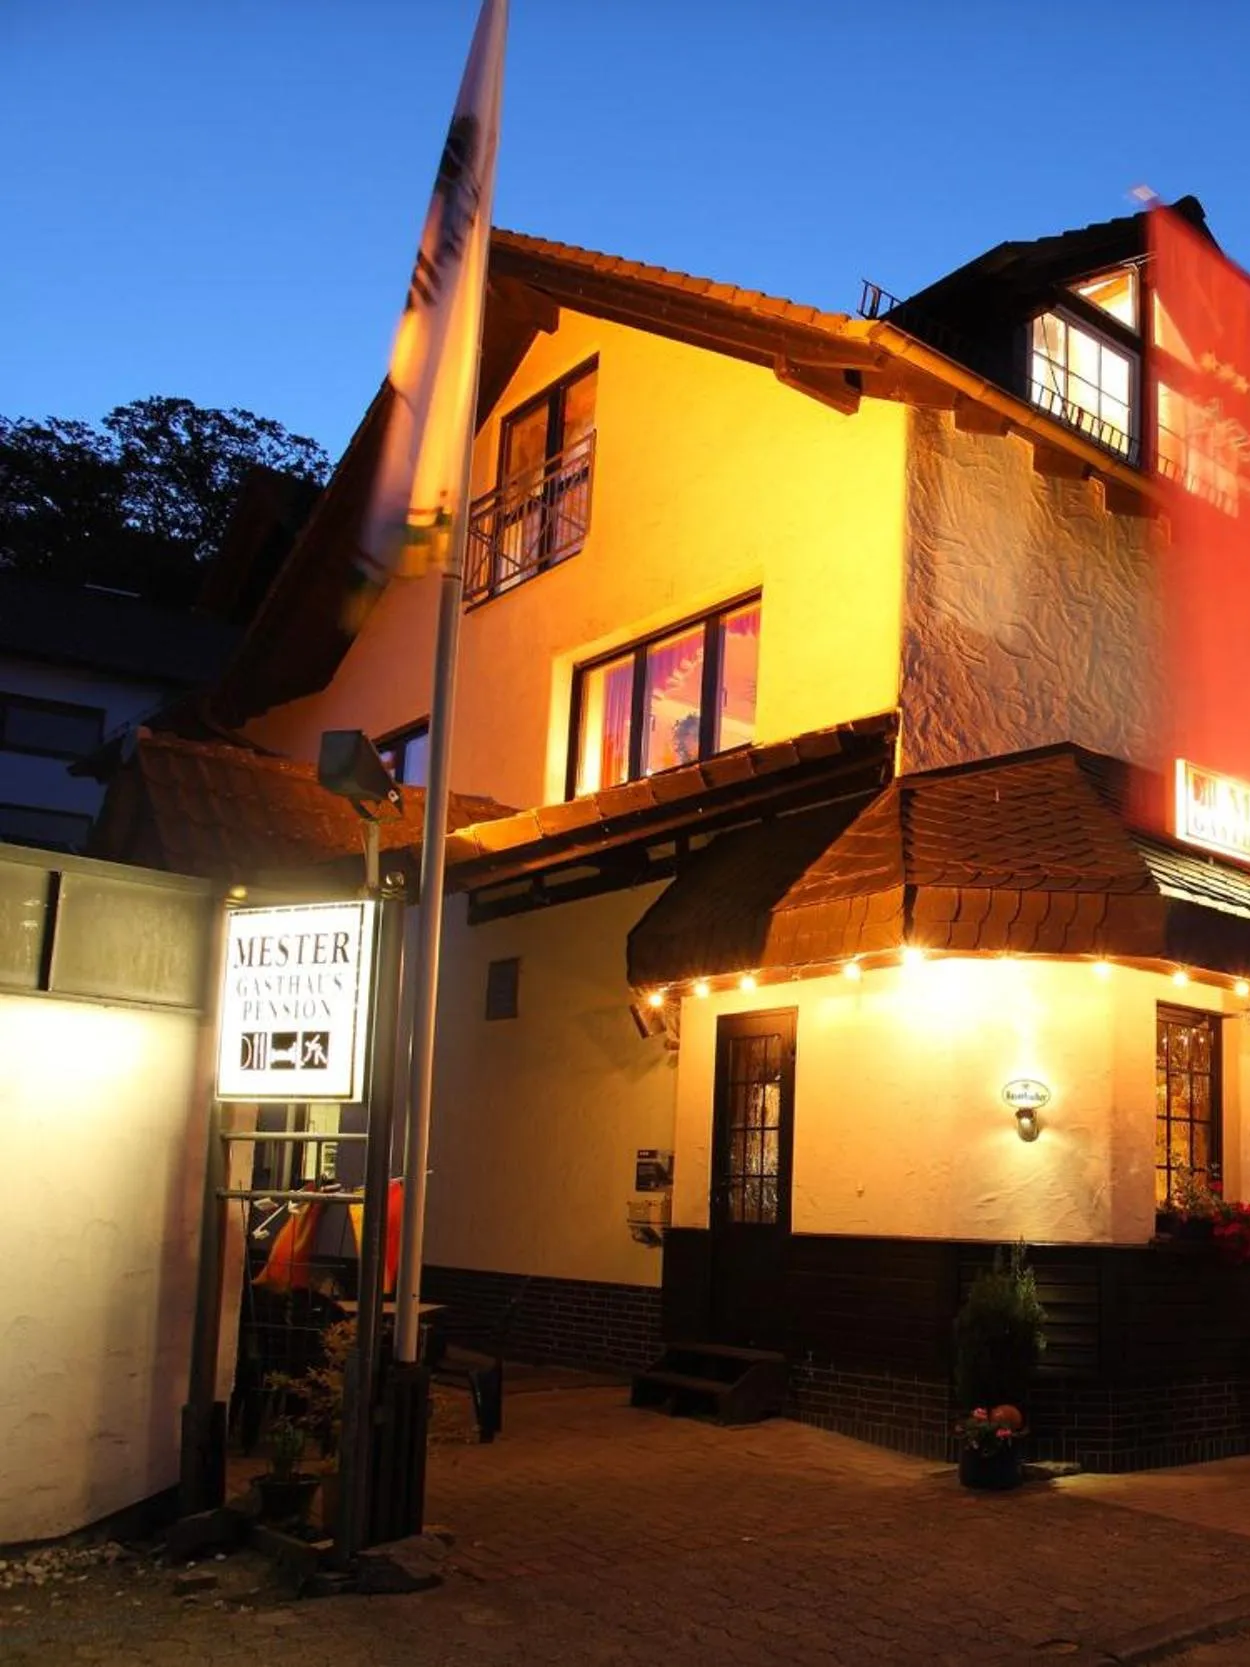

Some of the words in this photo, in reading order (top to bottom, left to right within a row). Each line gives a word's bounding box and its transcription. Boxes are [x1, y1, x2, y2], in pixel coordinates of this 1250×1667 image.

[233, 930, 350, 968] MESTER
[235, 972, 344, 998] GASTHAUS
[242, 999, 331, 1021] PENSION
